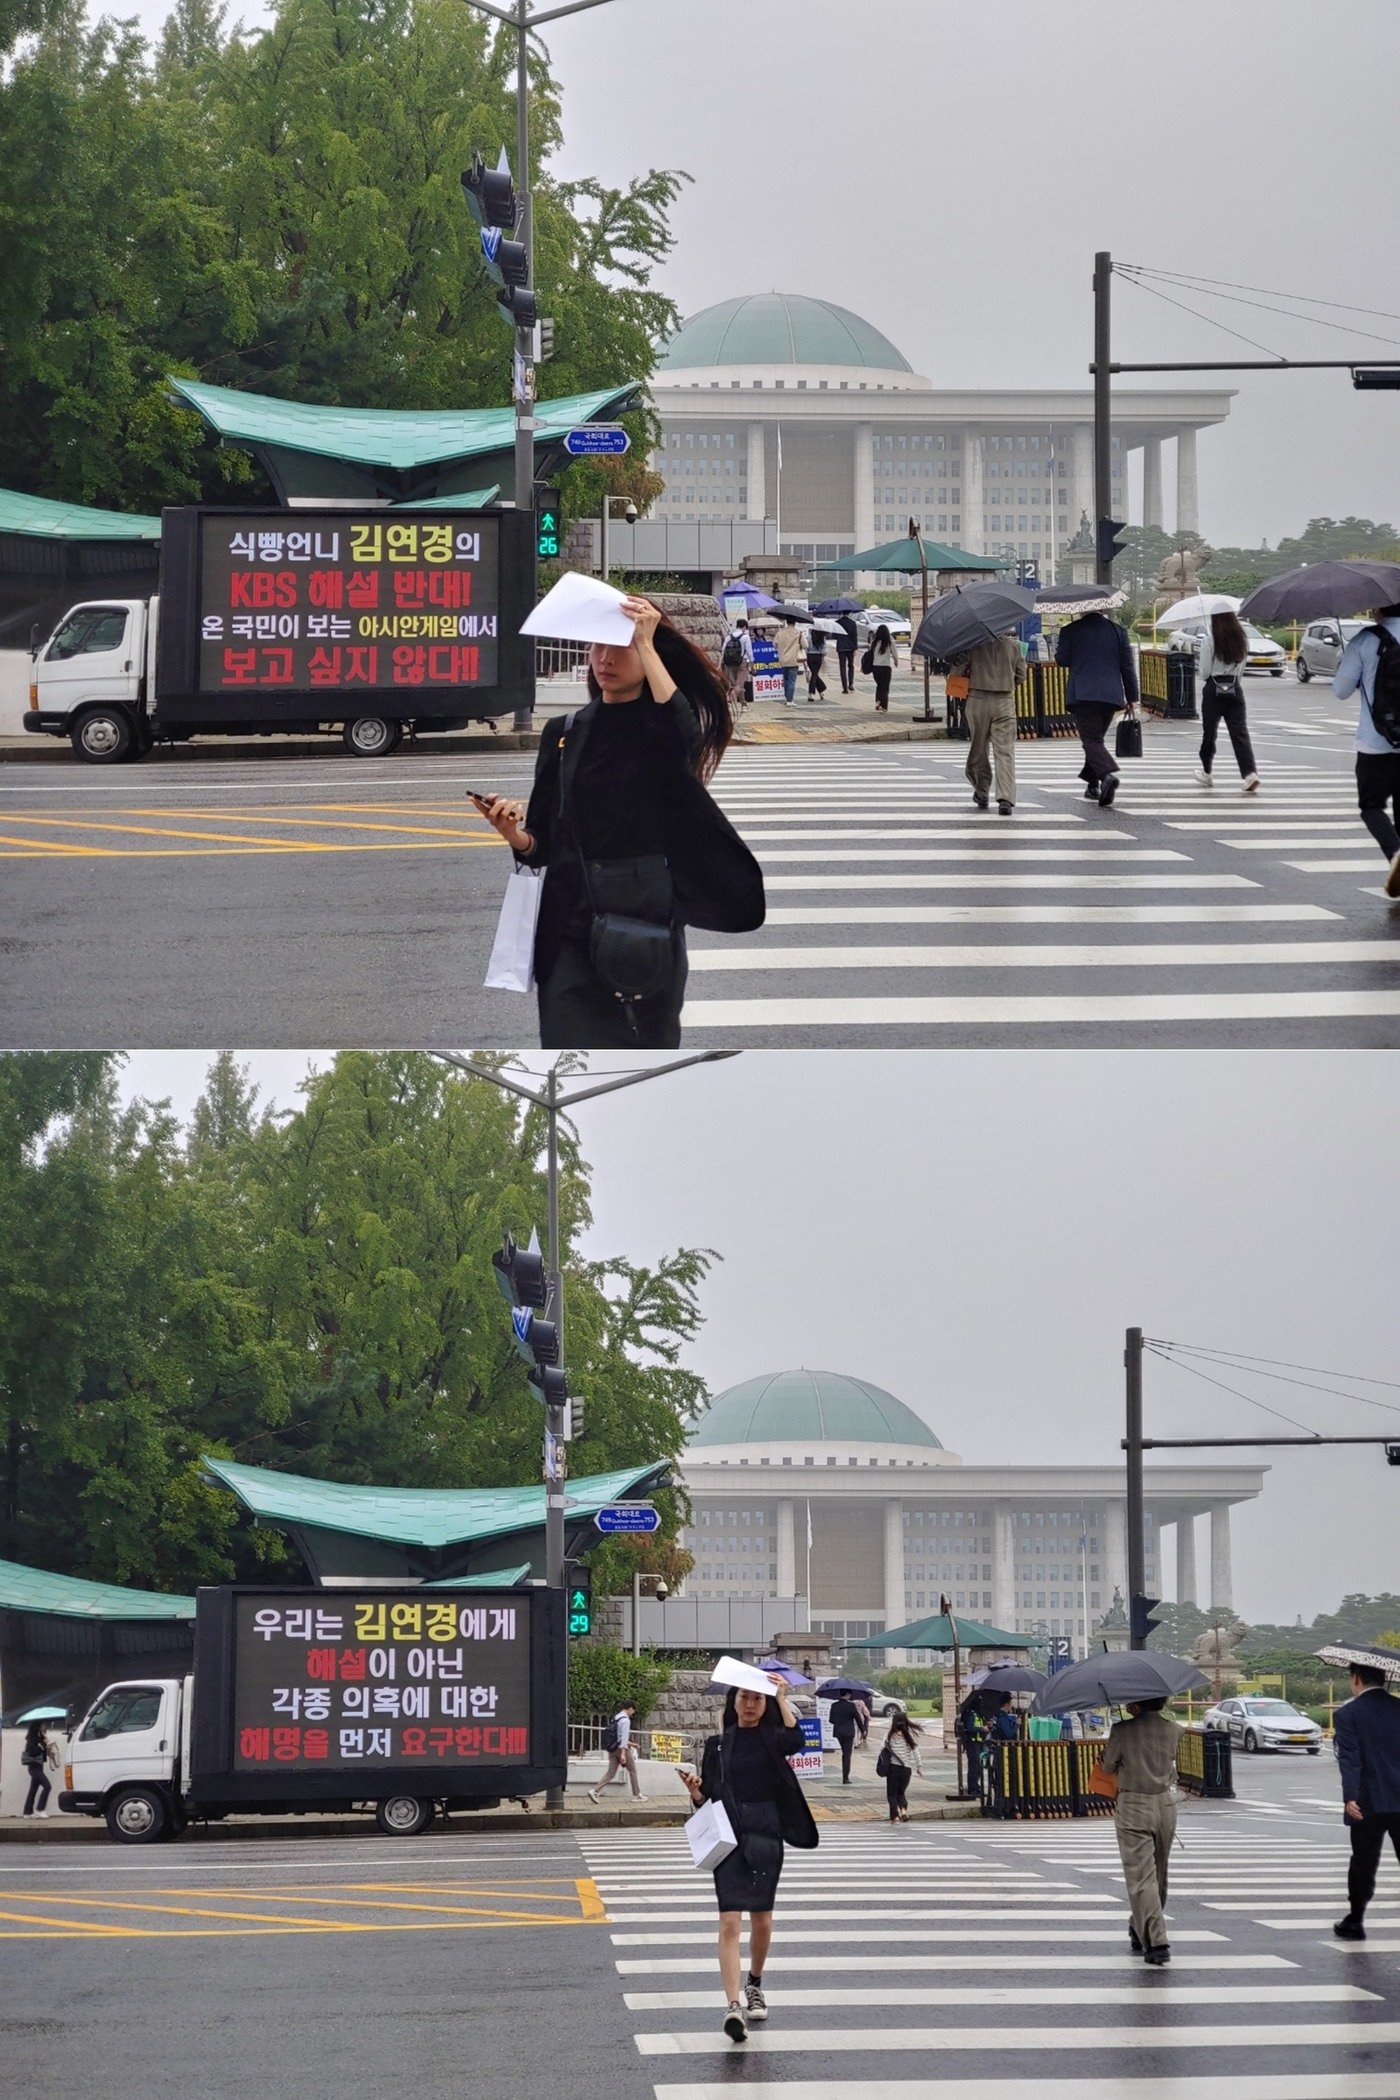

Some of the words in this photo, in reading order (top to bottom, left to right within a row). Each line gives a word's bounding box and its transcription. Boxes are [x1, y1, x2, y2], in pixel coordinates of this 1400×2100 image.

[229, 532, 339, 562] 식빵언니
[350, 525, 480, 563] 김연경의
[540, 537, 557, 554] 26
[230, 571, 297, 608] KBS
[308, 570, 378, 609] 해설
[393, 570, 471, 609] 반대!
[201, 615, 224, 640] 온
[231, 615, 299, 639] 국민이
[306, 615, 351, 639] 보는
[358, 615, 497, 639] 아시안게임에서
[221, 647, 294, 685] 보고
[307, 646, 377, 685] 싶지
[391, 645, 479, 685] 않다!!
[253, 1608, 343, 1641] 우리는
[354, 1604, 516, 1641] 김연경에게
[570, 1615, 588, 1632] 29
[306, 1648, 396, 1681] 해설이
[406, 1648, 463, 1680] 아닌
[272, 1687, 331, 1720] 각종
[341, 1686, 430, 1719] 의혹에
[440, 1686, 498, 1718] 대한
[239, 1726, 329, 1761] 해명을
[339, 1728, 392, 1758] 먼저
[400, 1726, 527, 1757] 요구한다!!!
